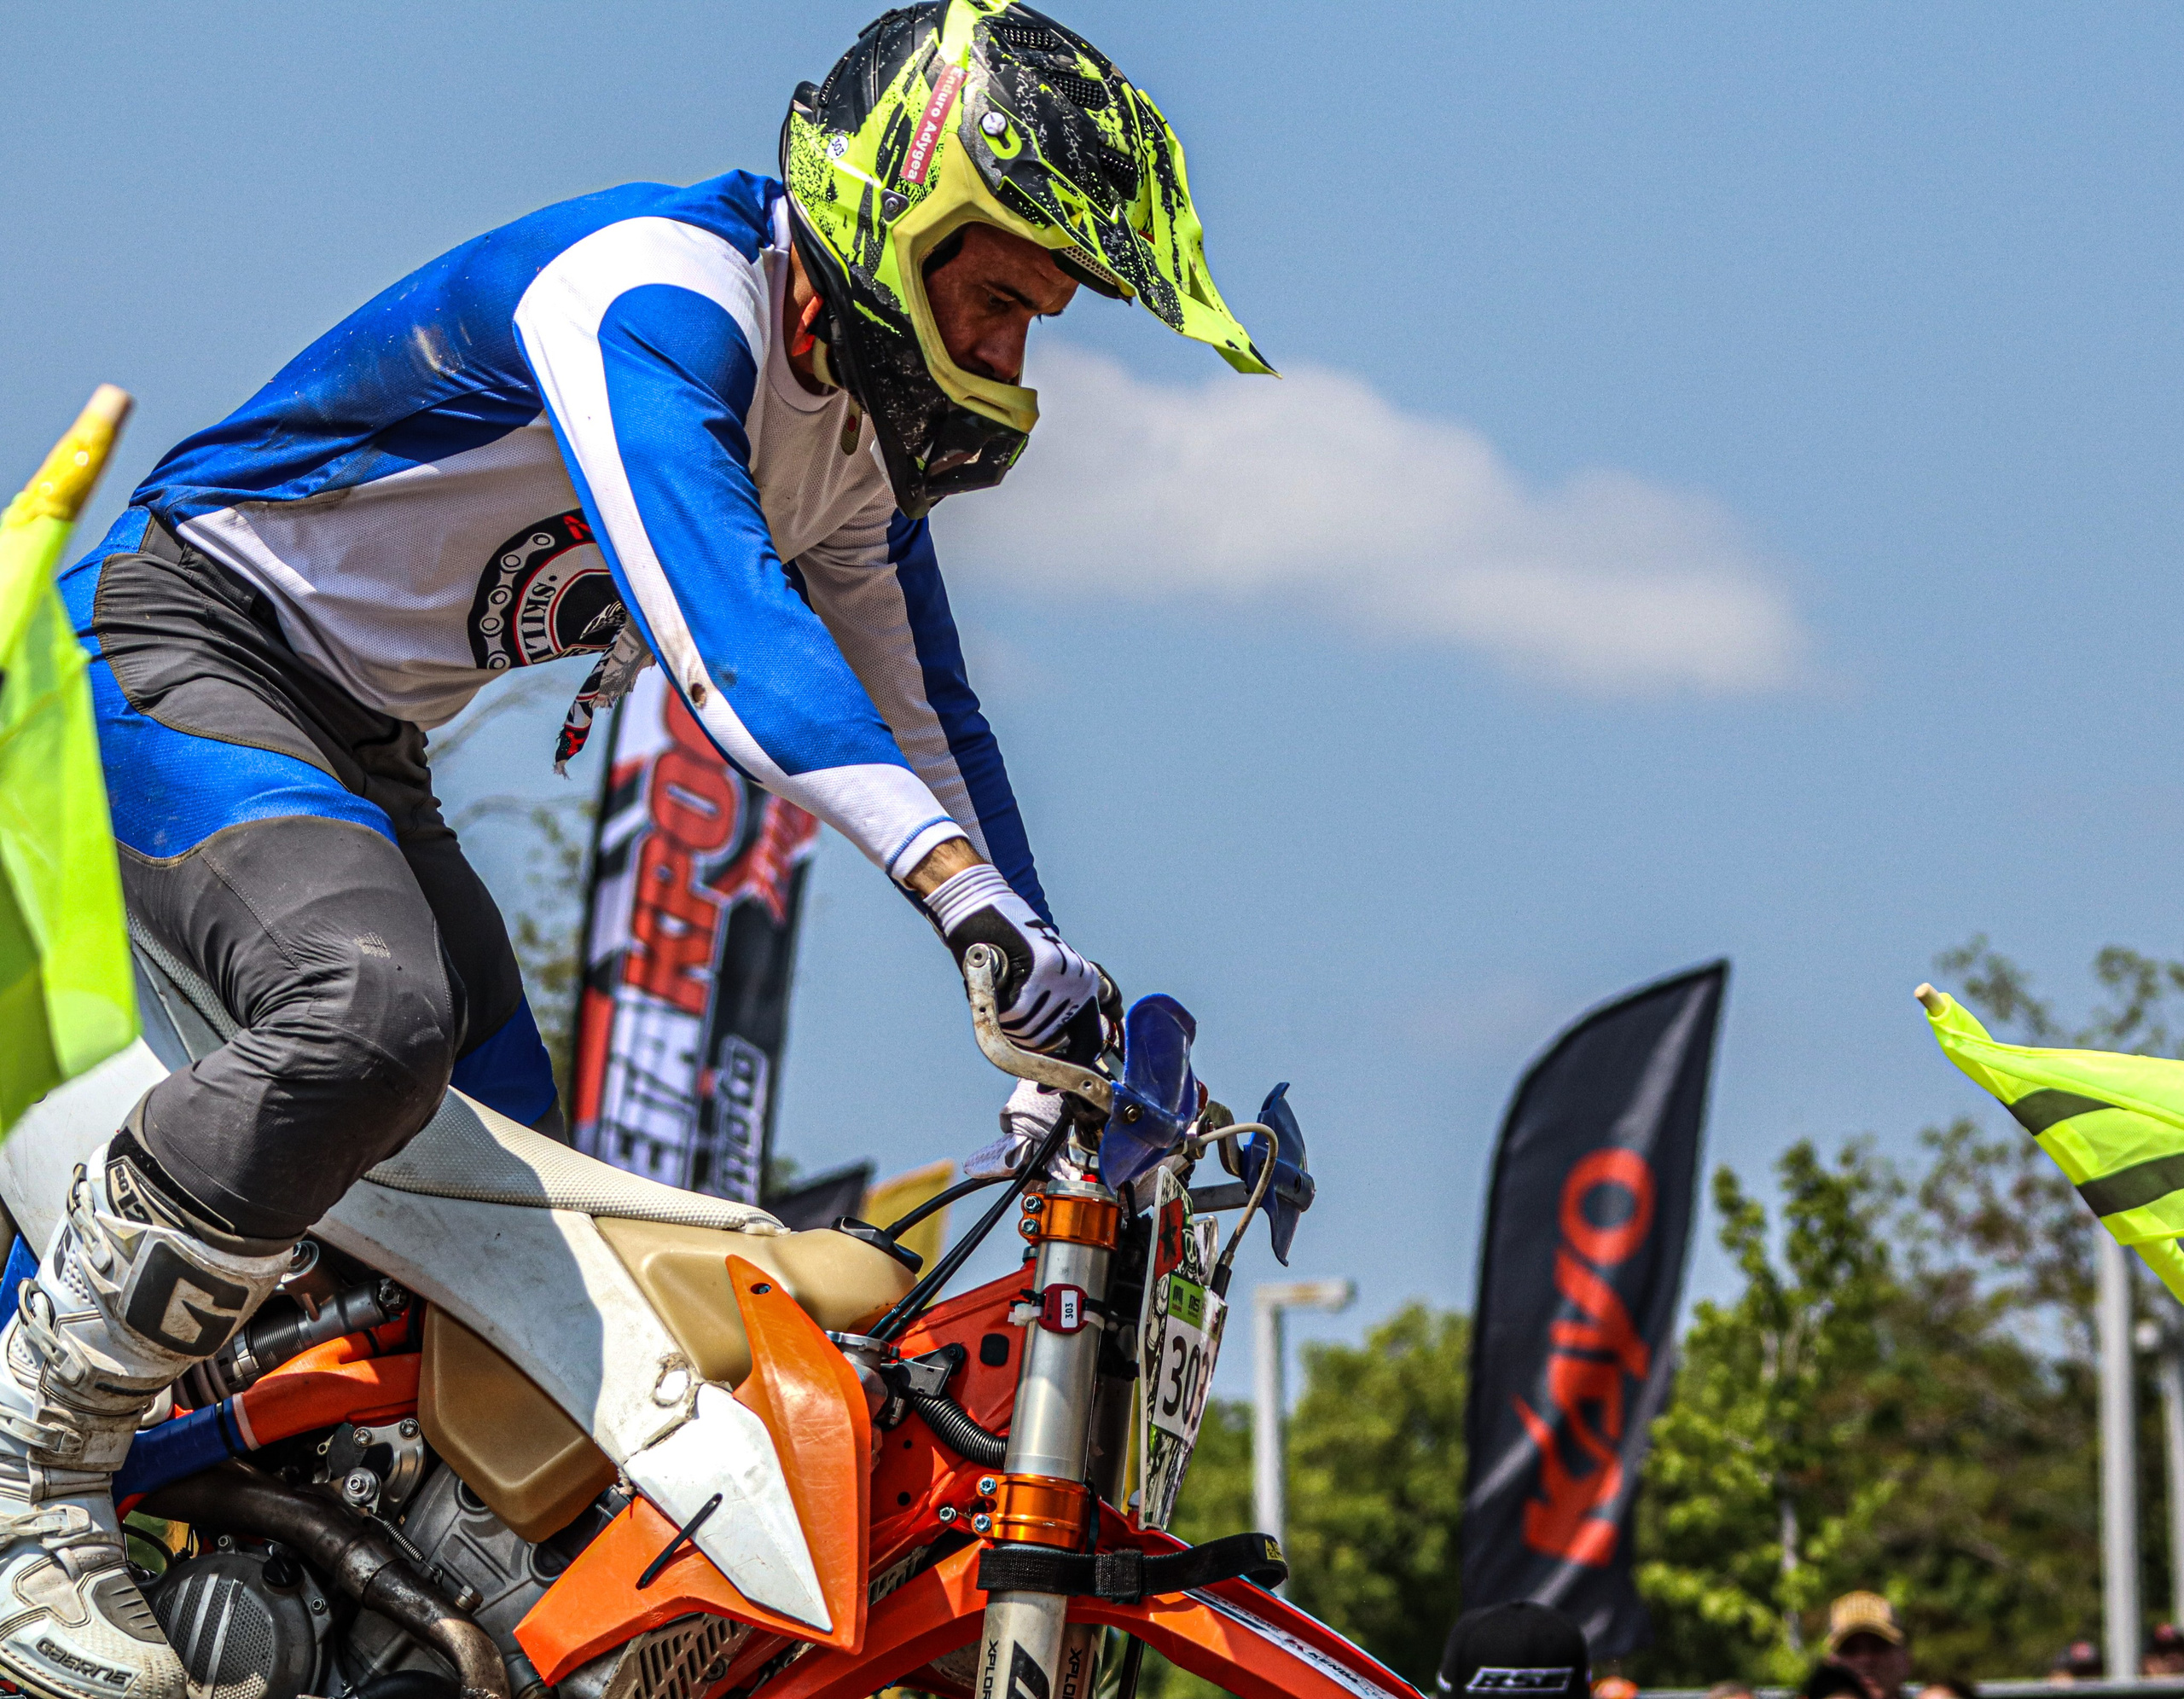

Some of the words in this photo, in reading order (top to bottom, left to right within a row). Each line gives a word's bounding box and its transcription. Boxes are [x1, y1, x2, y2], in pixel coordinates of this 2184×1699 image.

[931, 67, 965, 118] Enduro
[832, 137, 844, 157] 303
[907, 120, 938, 180] Adygea
[1162, 1335, 1210, 1430] 303
[1307, 1651, 1359, 1683] KENDA
